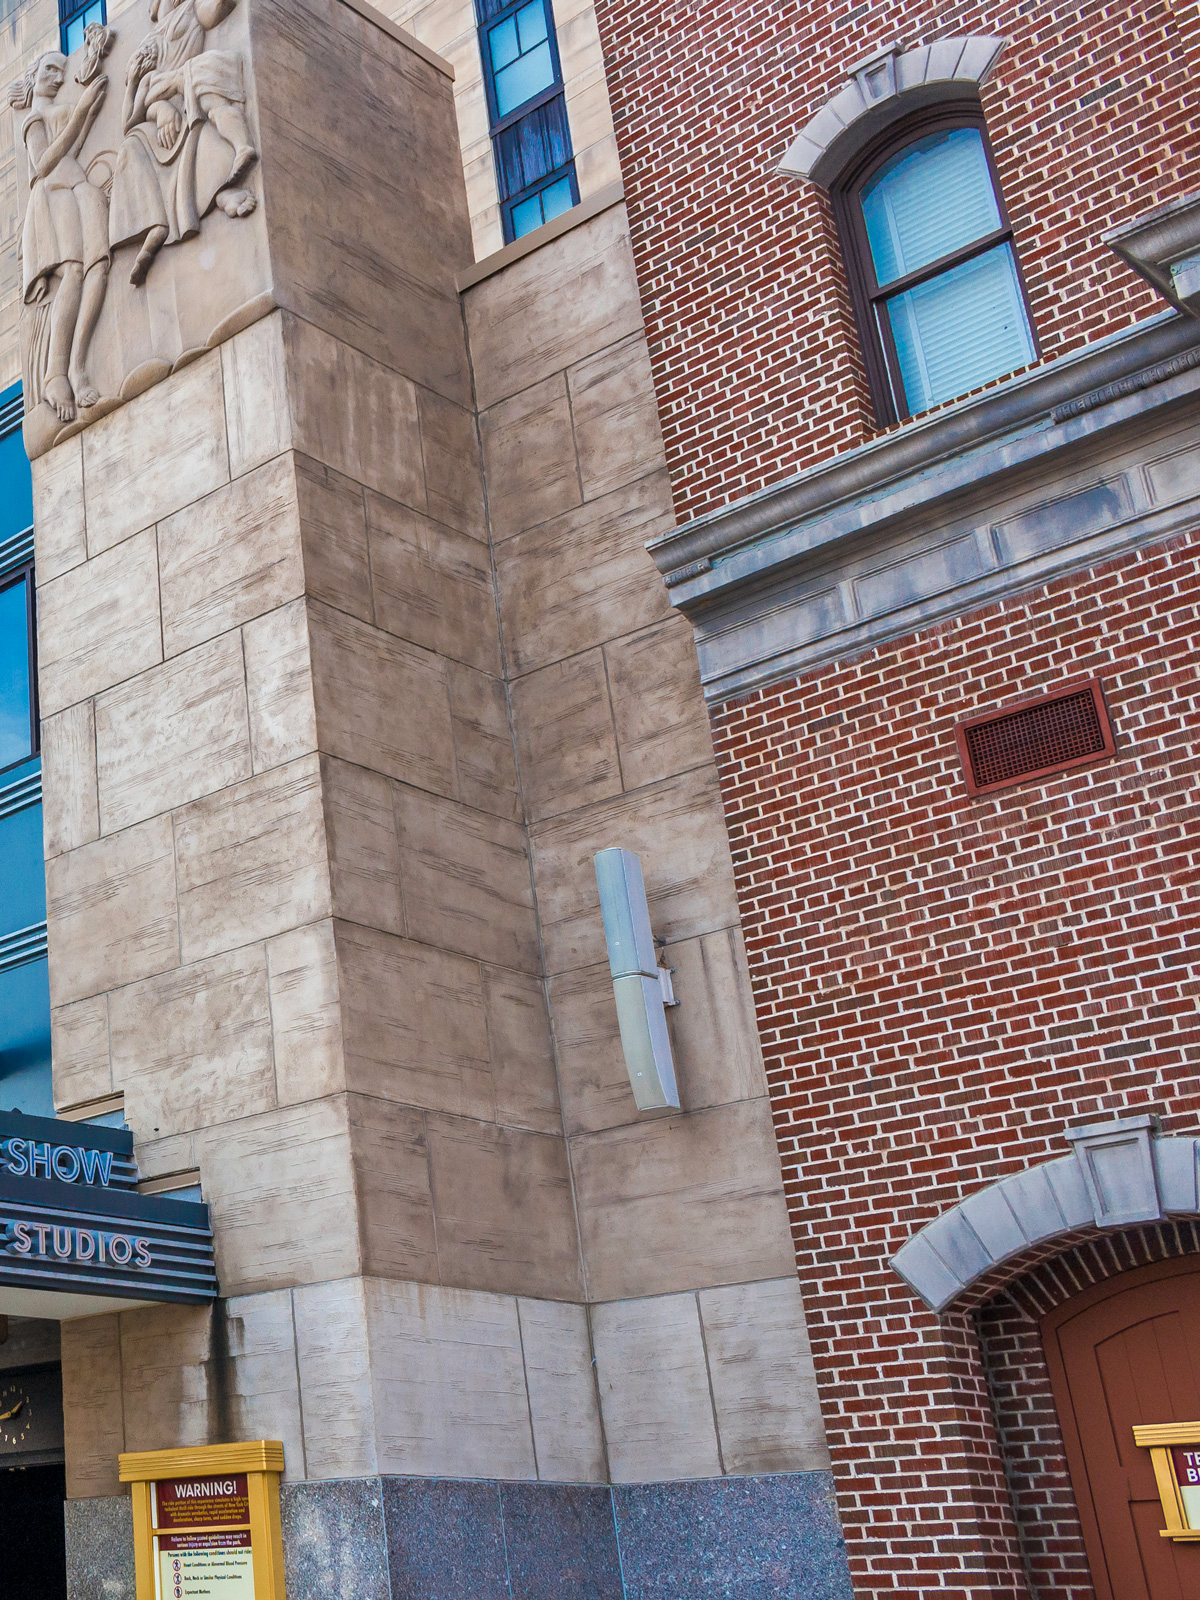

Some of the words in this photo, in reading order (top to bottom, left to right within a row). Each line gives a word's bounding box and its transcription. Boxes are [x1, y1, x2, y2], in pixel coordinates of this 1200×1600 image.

[3, 1137, 114, 1187] SHOW
[7, 1222, 152, 1268] STUDIOS
[174, 1480, 237, 1498] WARNING!
